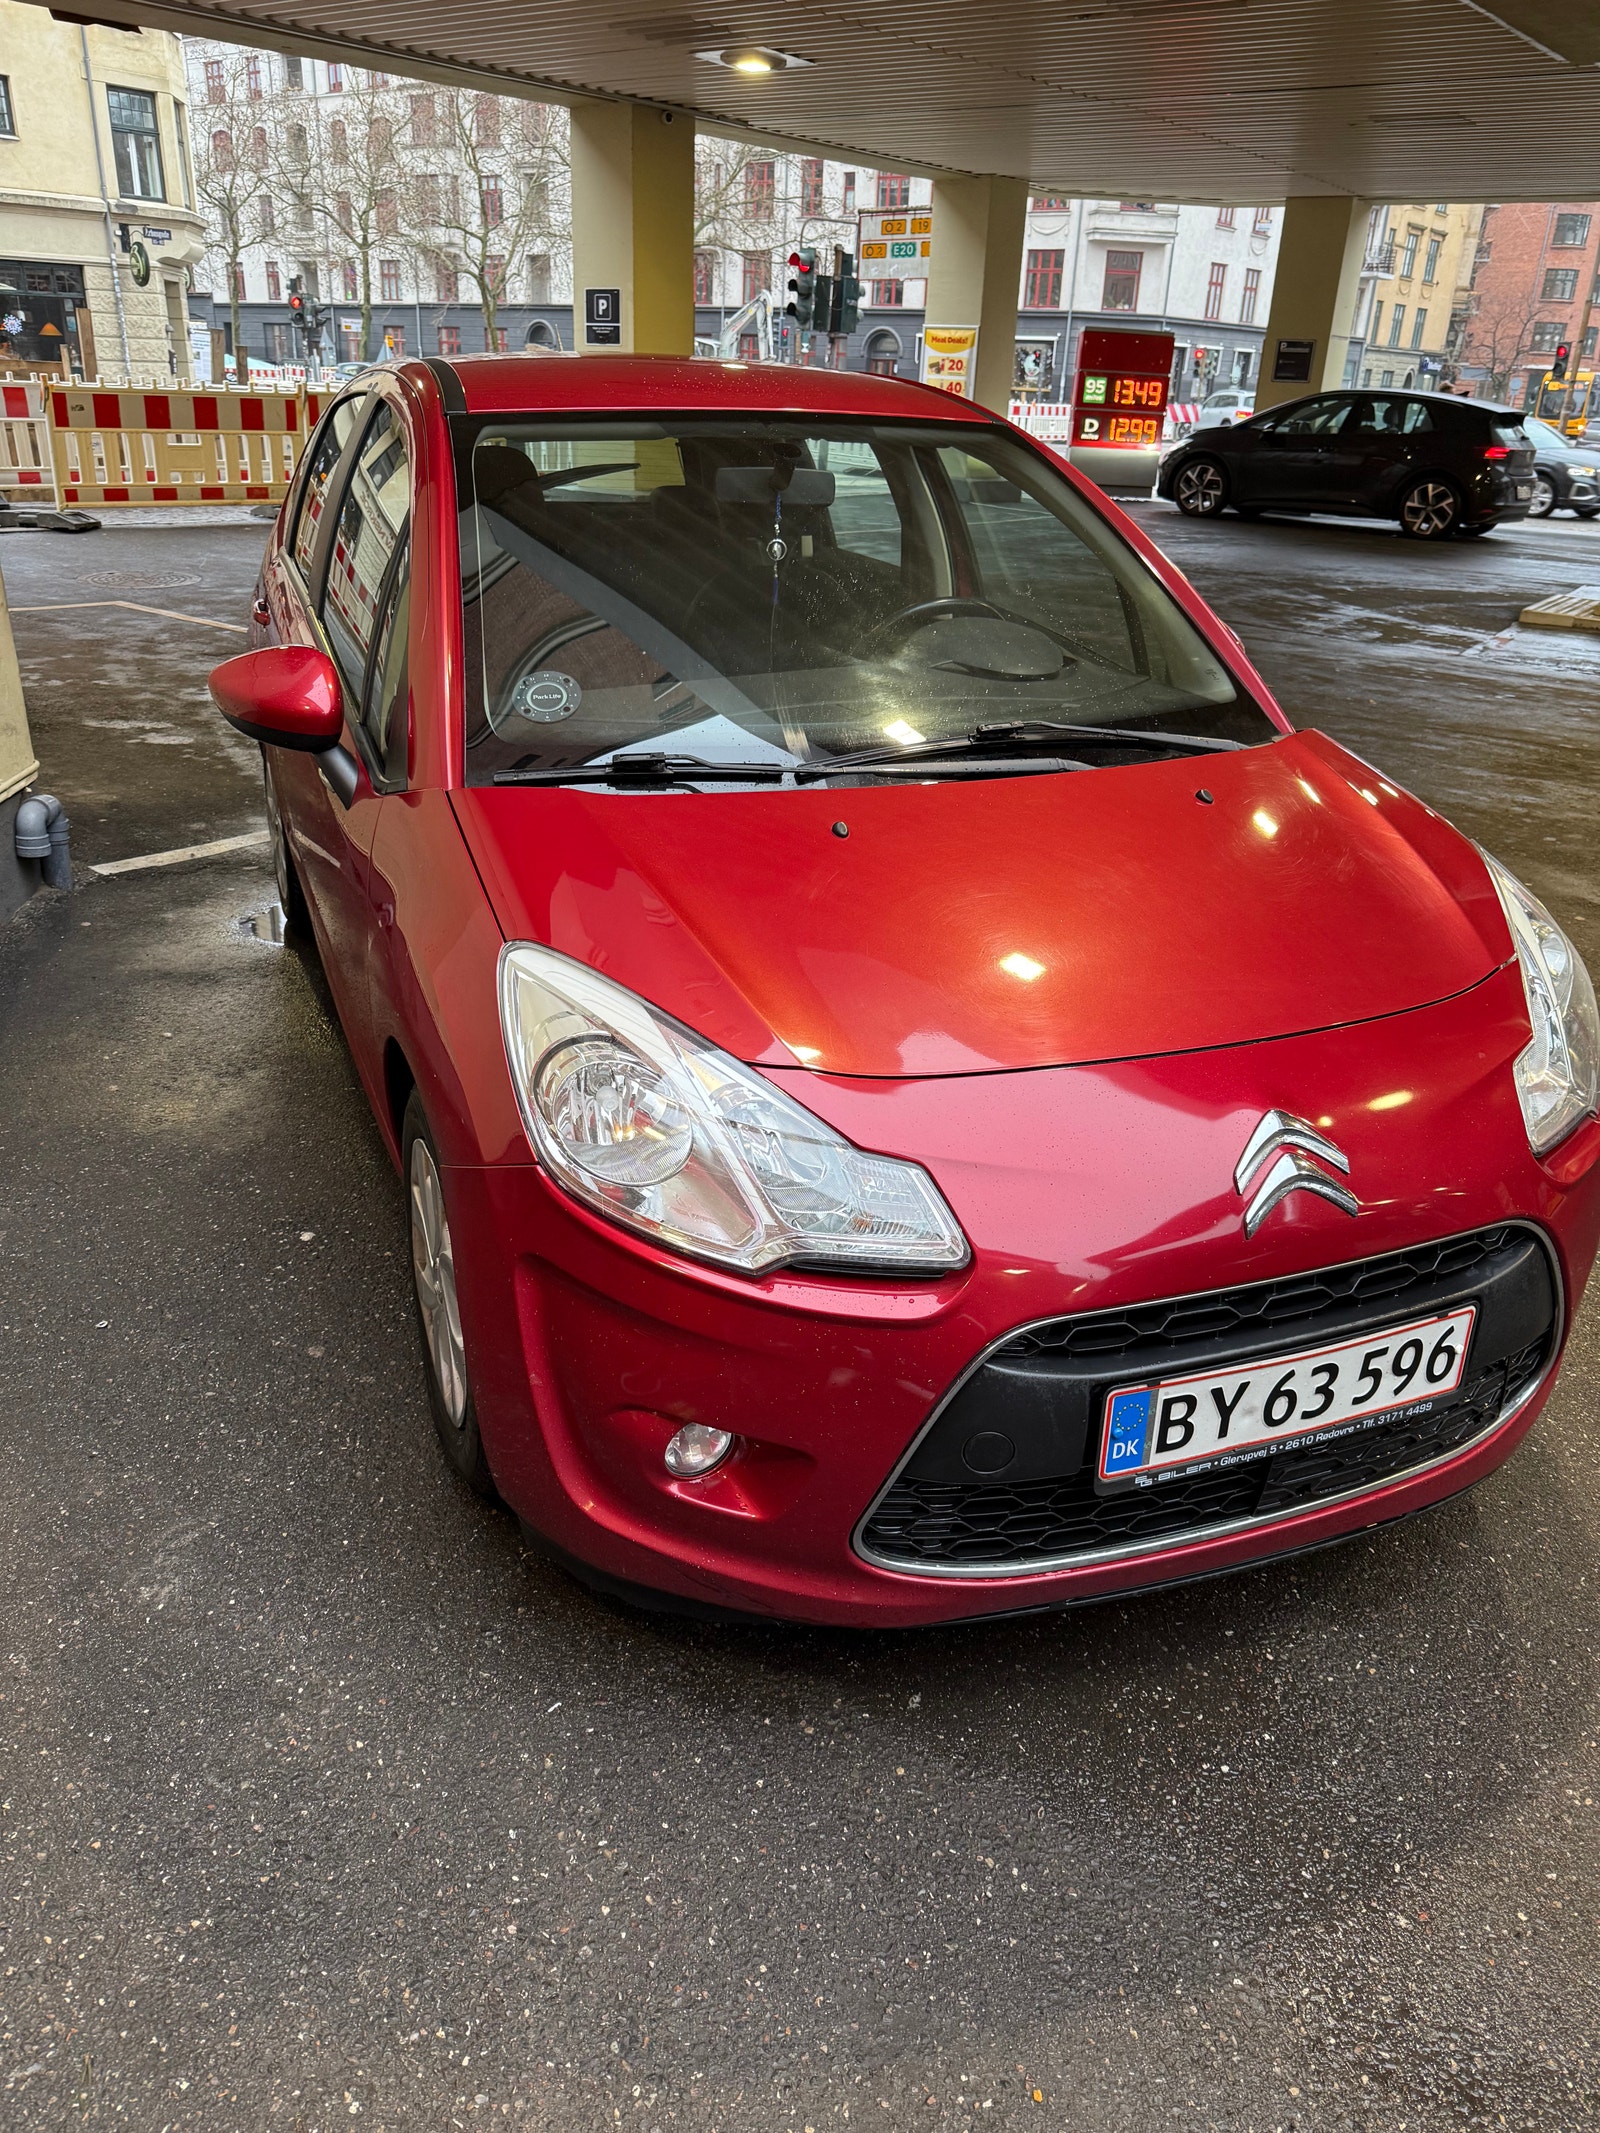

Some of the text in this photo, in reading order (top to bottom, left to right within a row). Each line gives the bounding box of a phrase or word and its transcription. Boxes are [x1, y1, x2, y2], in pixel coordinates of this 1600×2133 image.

[893, 244, 914, 256] E20
[598, 299, 608, 316] P
[931, 336, 969, 345] Meal Deals!
[1085, 379, 1106, 394] 95
[1083, 418, 1099, 433] D
[1155, 1325, 1456, 1454] BY 63 596
[1220, 1447, 1268, 1466] Glerupvej
[1269, 1444, 1278, 1455] 5
[1285, 1435, 1313, 1450] 2610
[1316, 1426, 1355, 1442] Rødovre
[1362, 1418, 1376, 1430] Tlf.
[1377, 1410, 1404, 1425] 3171
[1406, 1401, 1433, 1416] 4499
[1112, 1438, 1140, 1460] DK
